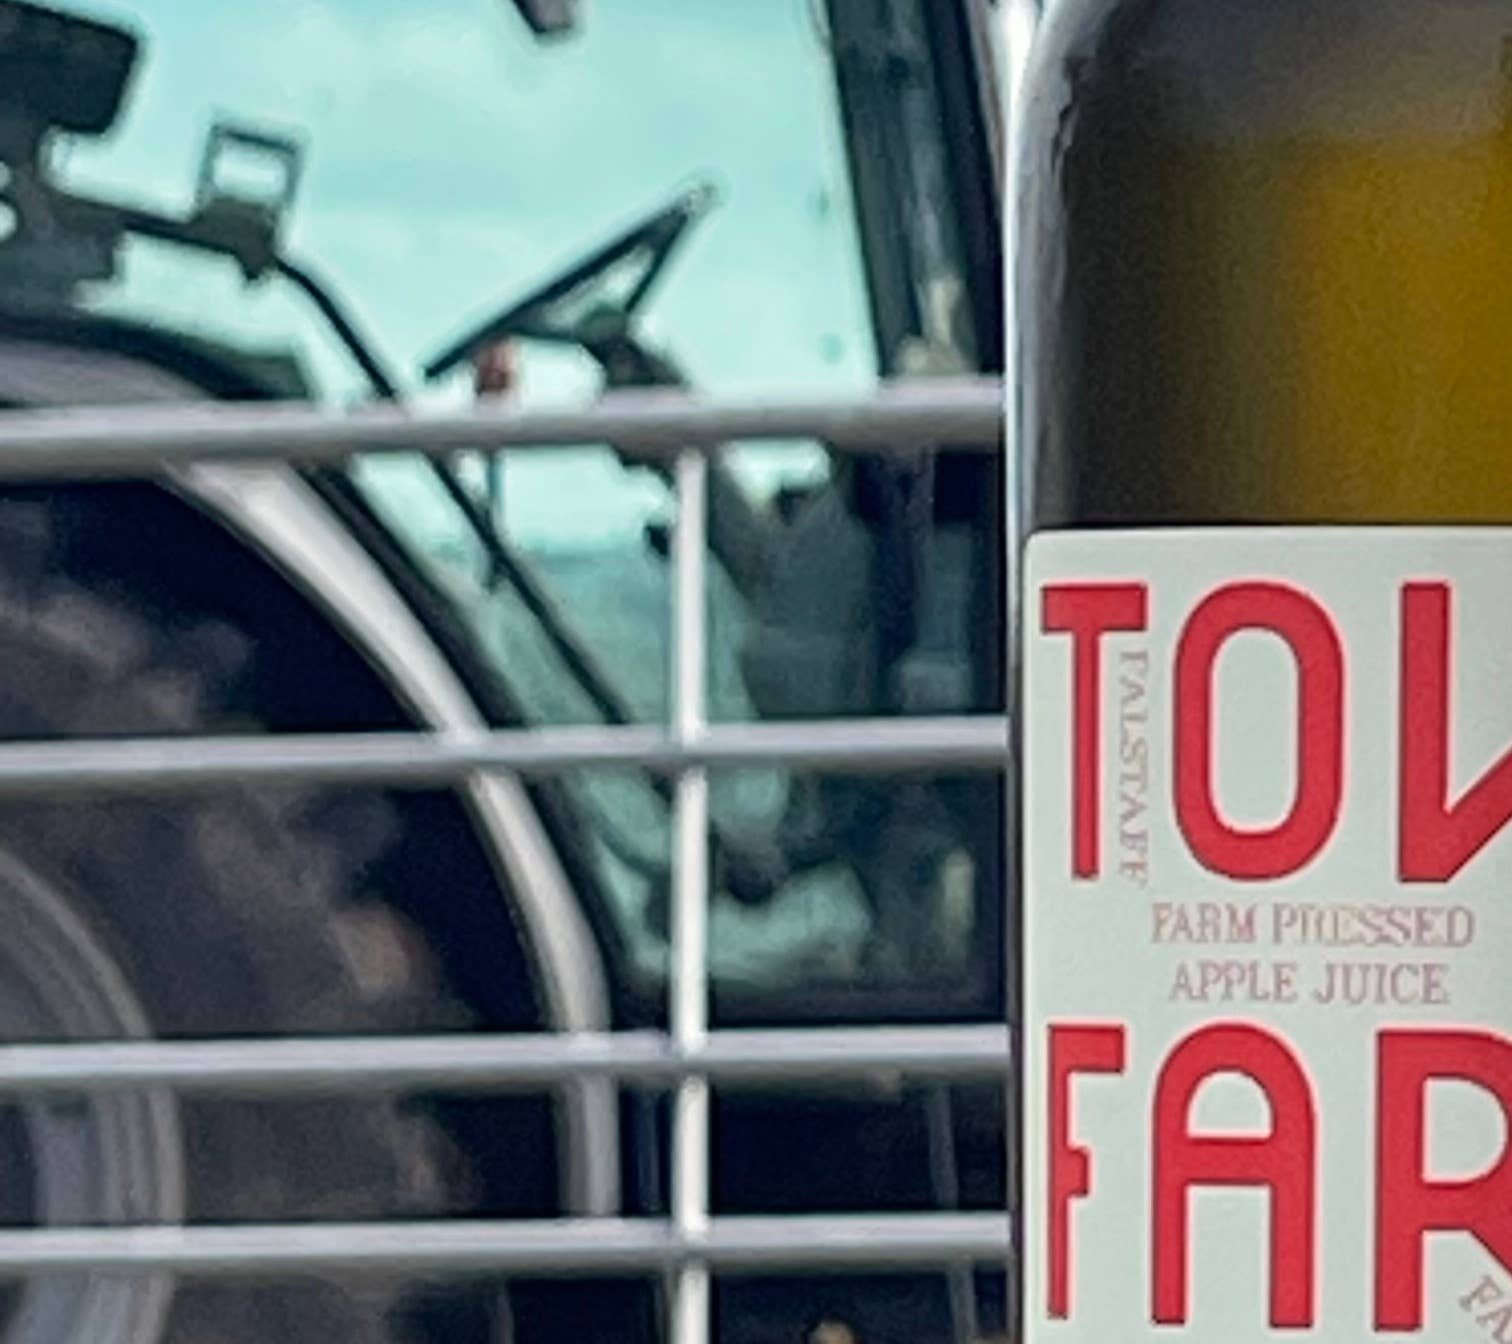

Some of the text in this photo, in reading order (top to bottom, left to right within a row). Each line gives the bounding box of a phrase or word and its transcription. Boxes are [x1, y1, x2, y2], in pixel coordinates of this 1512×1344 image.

[1118, 650, 1148, 887] FALSTAFF
[1151, 902, 1475, 948] FARM PRESSED
[1168, 961, 1449, 1006] APPLE JUICE
